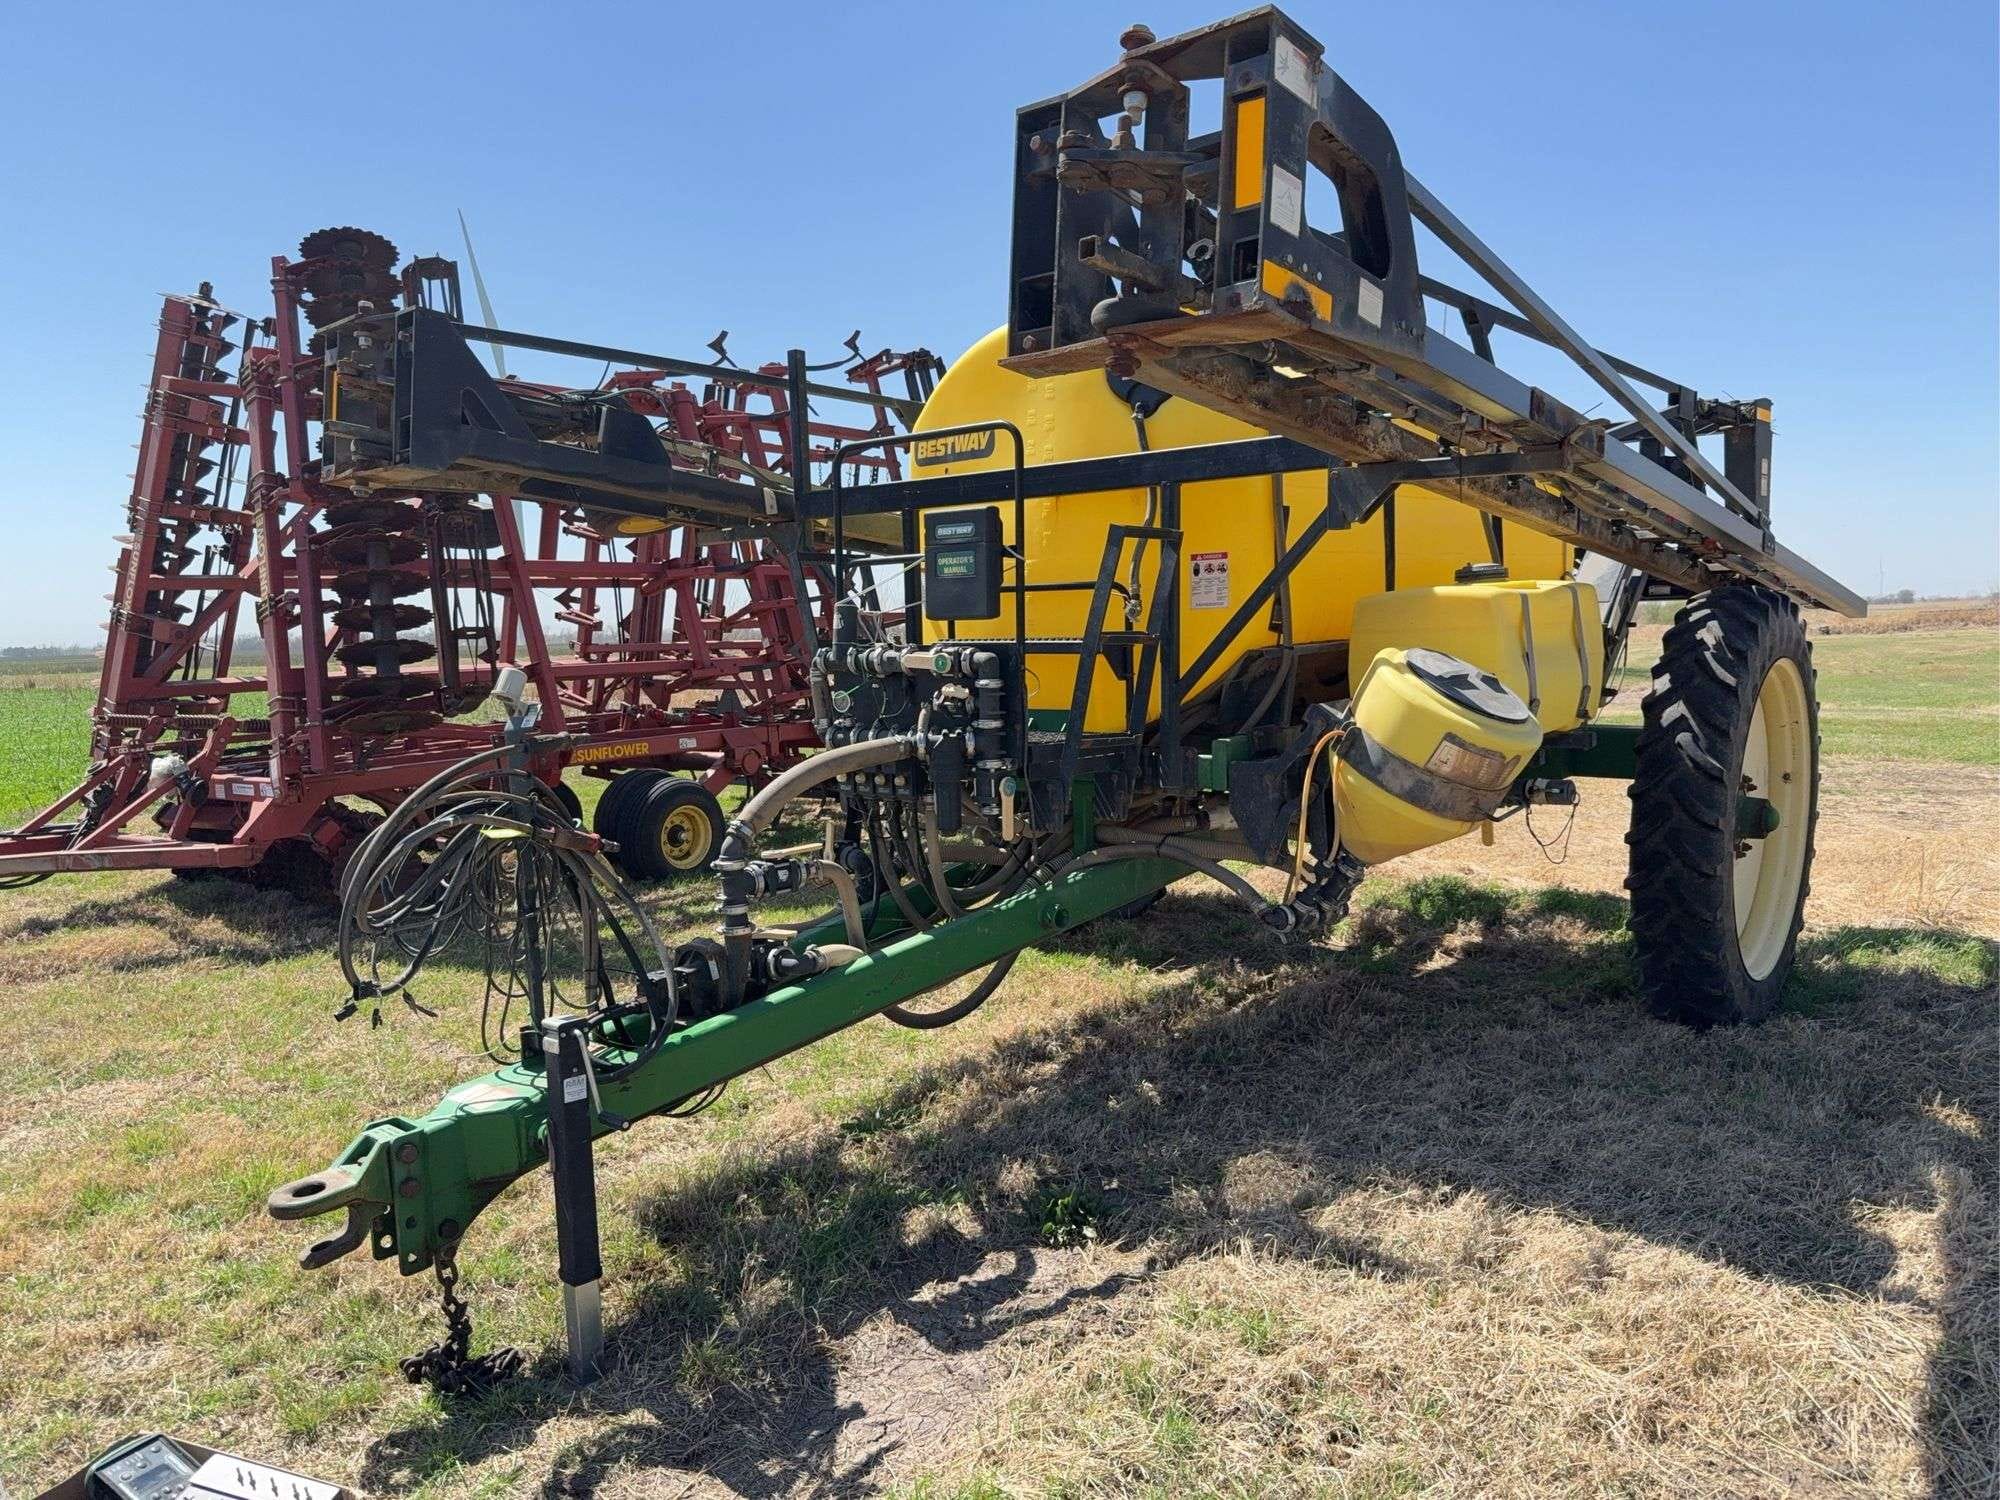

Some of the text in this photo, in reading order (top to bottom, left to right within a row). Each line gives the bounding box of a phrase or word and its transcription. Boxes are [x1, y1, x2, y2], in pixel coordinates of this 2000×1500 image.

[918, 431, 991, 459] BESTWAY
[937, 525, 974, 536] BESTWAY
[938, 555, 974, 565] OPERATOR'S
[943, 566, 968, 574] MANUAL
[575, 743, 649, 761] SUNFLOWER
